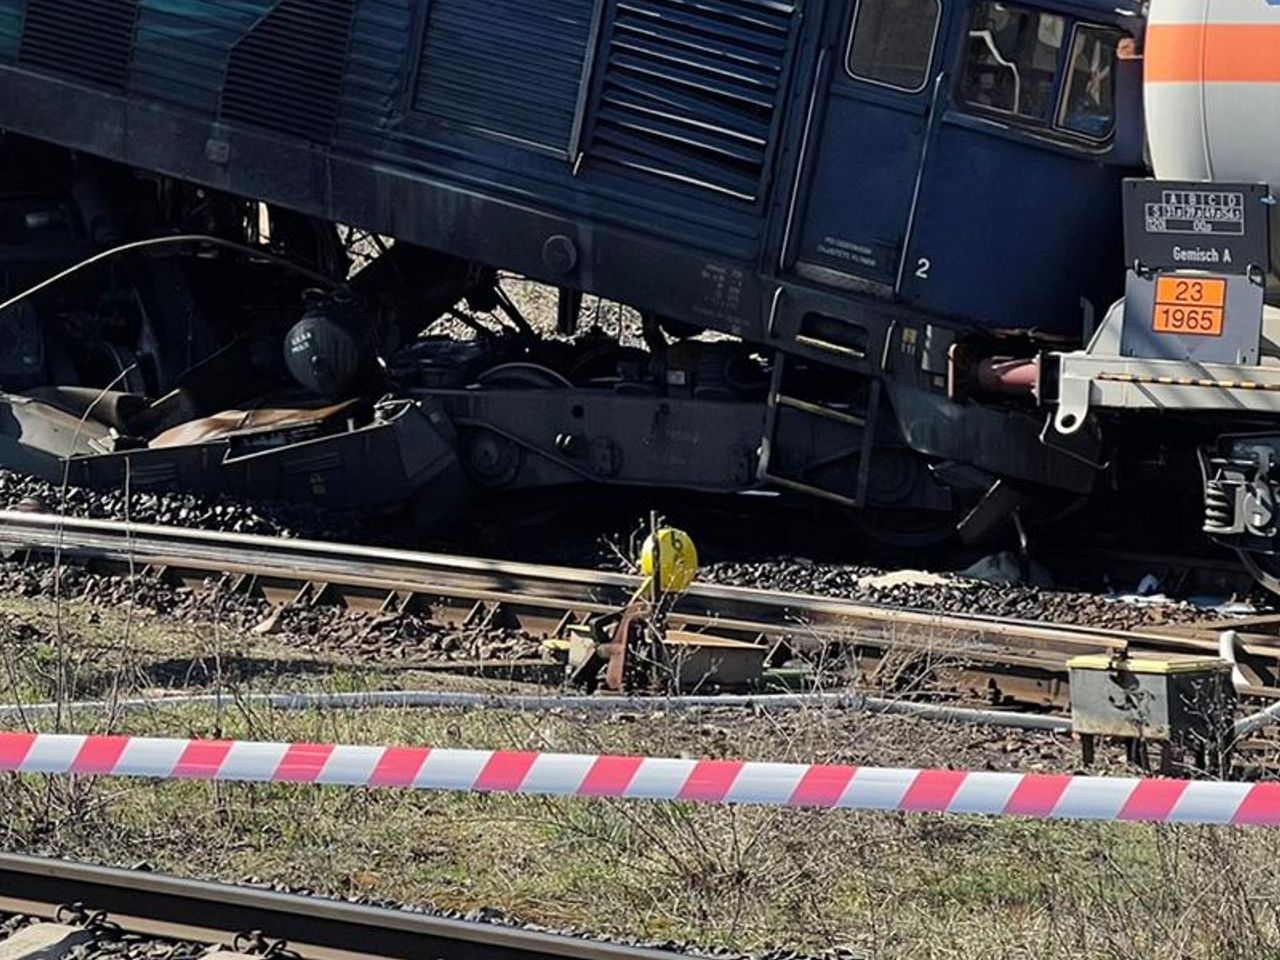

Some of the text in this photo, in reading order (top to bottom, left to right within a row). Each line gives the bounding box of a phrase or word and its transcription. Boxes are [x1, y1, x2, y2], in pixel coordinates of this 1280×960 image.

[1208, 194, 1216, 205] C
[1173, 246, 1232, 263] Gemisch A
[915, 257, 930, 279] 2
[1176, 281, 1203, 302] 23
[1162, 308, 1213, 331] 1965
